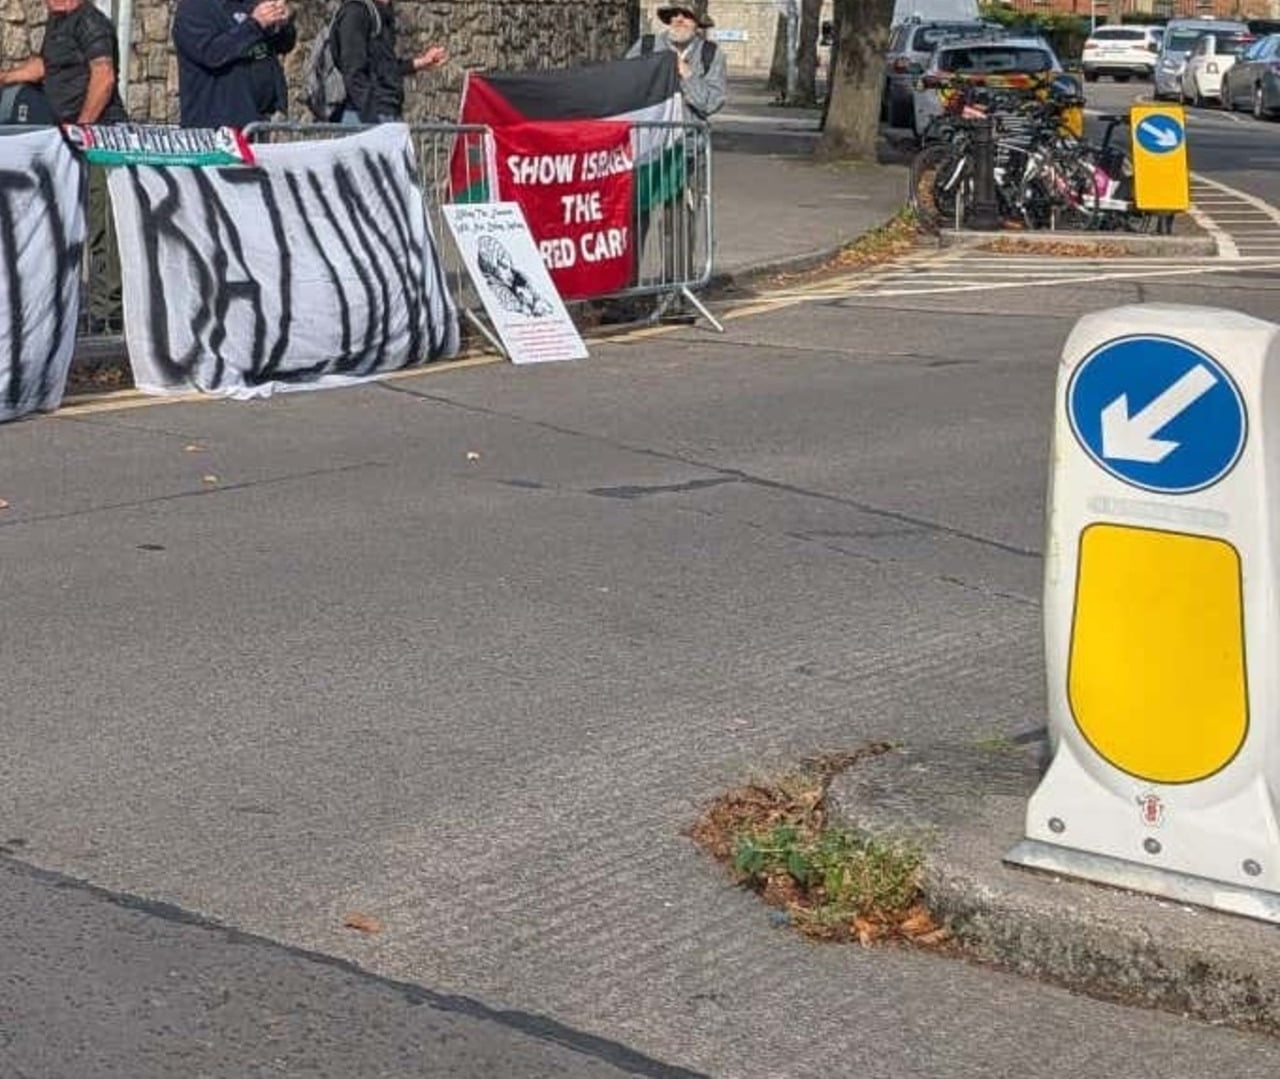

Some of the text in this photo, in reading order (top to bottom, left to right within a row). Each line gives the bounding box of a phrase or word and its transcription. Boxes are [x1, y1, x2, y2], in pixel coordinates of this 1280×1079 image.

[507, 154, 576, 184] SHOW
[561, 192, 604, 225] THE
[541, 237, 576, 270] RED
